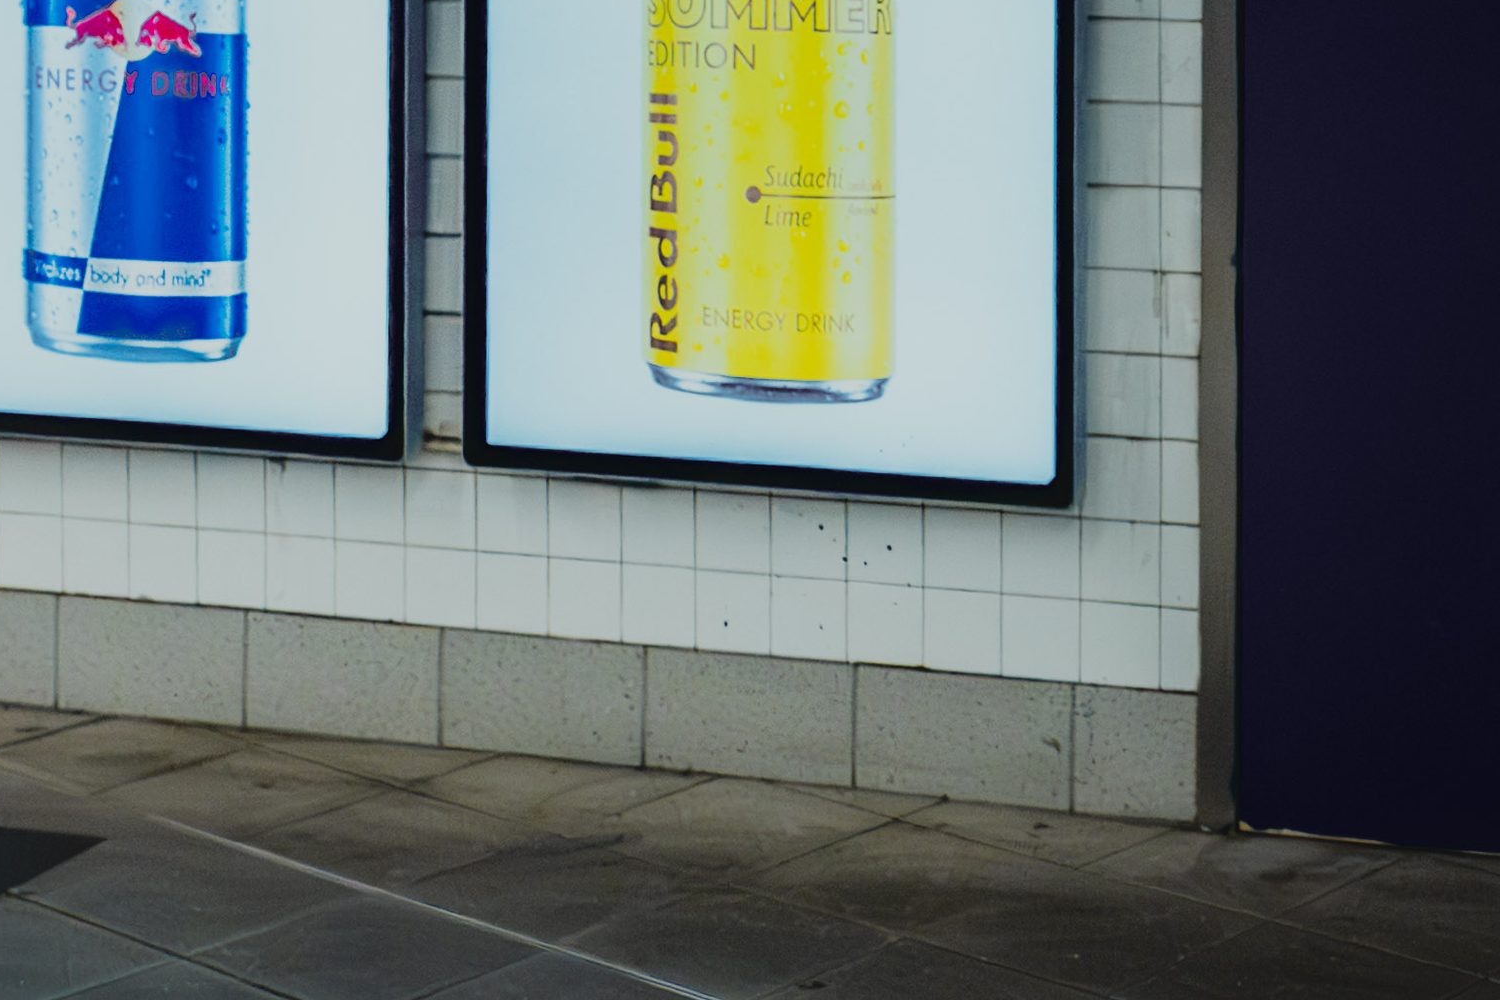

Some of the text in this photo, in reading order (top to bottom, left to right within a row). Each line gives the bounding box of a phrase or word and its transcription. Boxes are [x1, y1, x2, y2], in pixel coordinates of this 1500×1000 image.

[648, 40, 756, 70] EDITION
[35, 66, 230, 99] ENERGY DRINK
[764, 165, 843, 189] Sudachi
[649, 92, 679, 353] Red Bull
[764, 204, 812, 227] Lime
[90, 264, 129, 287] body
[136, 268, 166, 286] and
[702, 306, 855, 334] ENERGY DRINK
